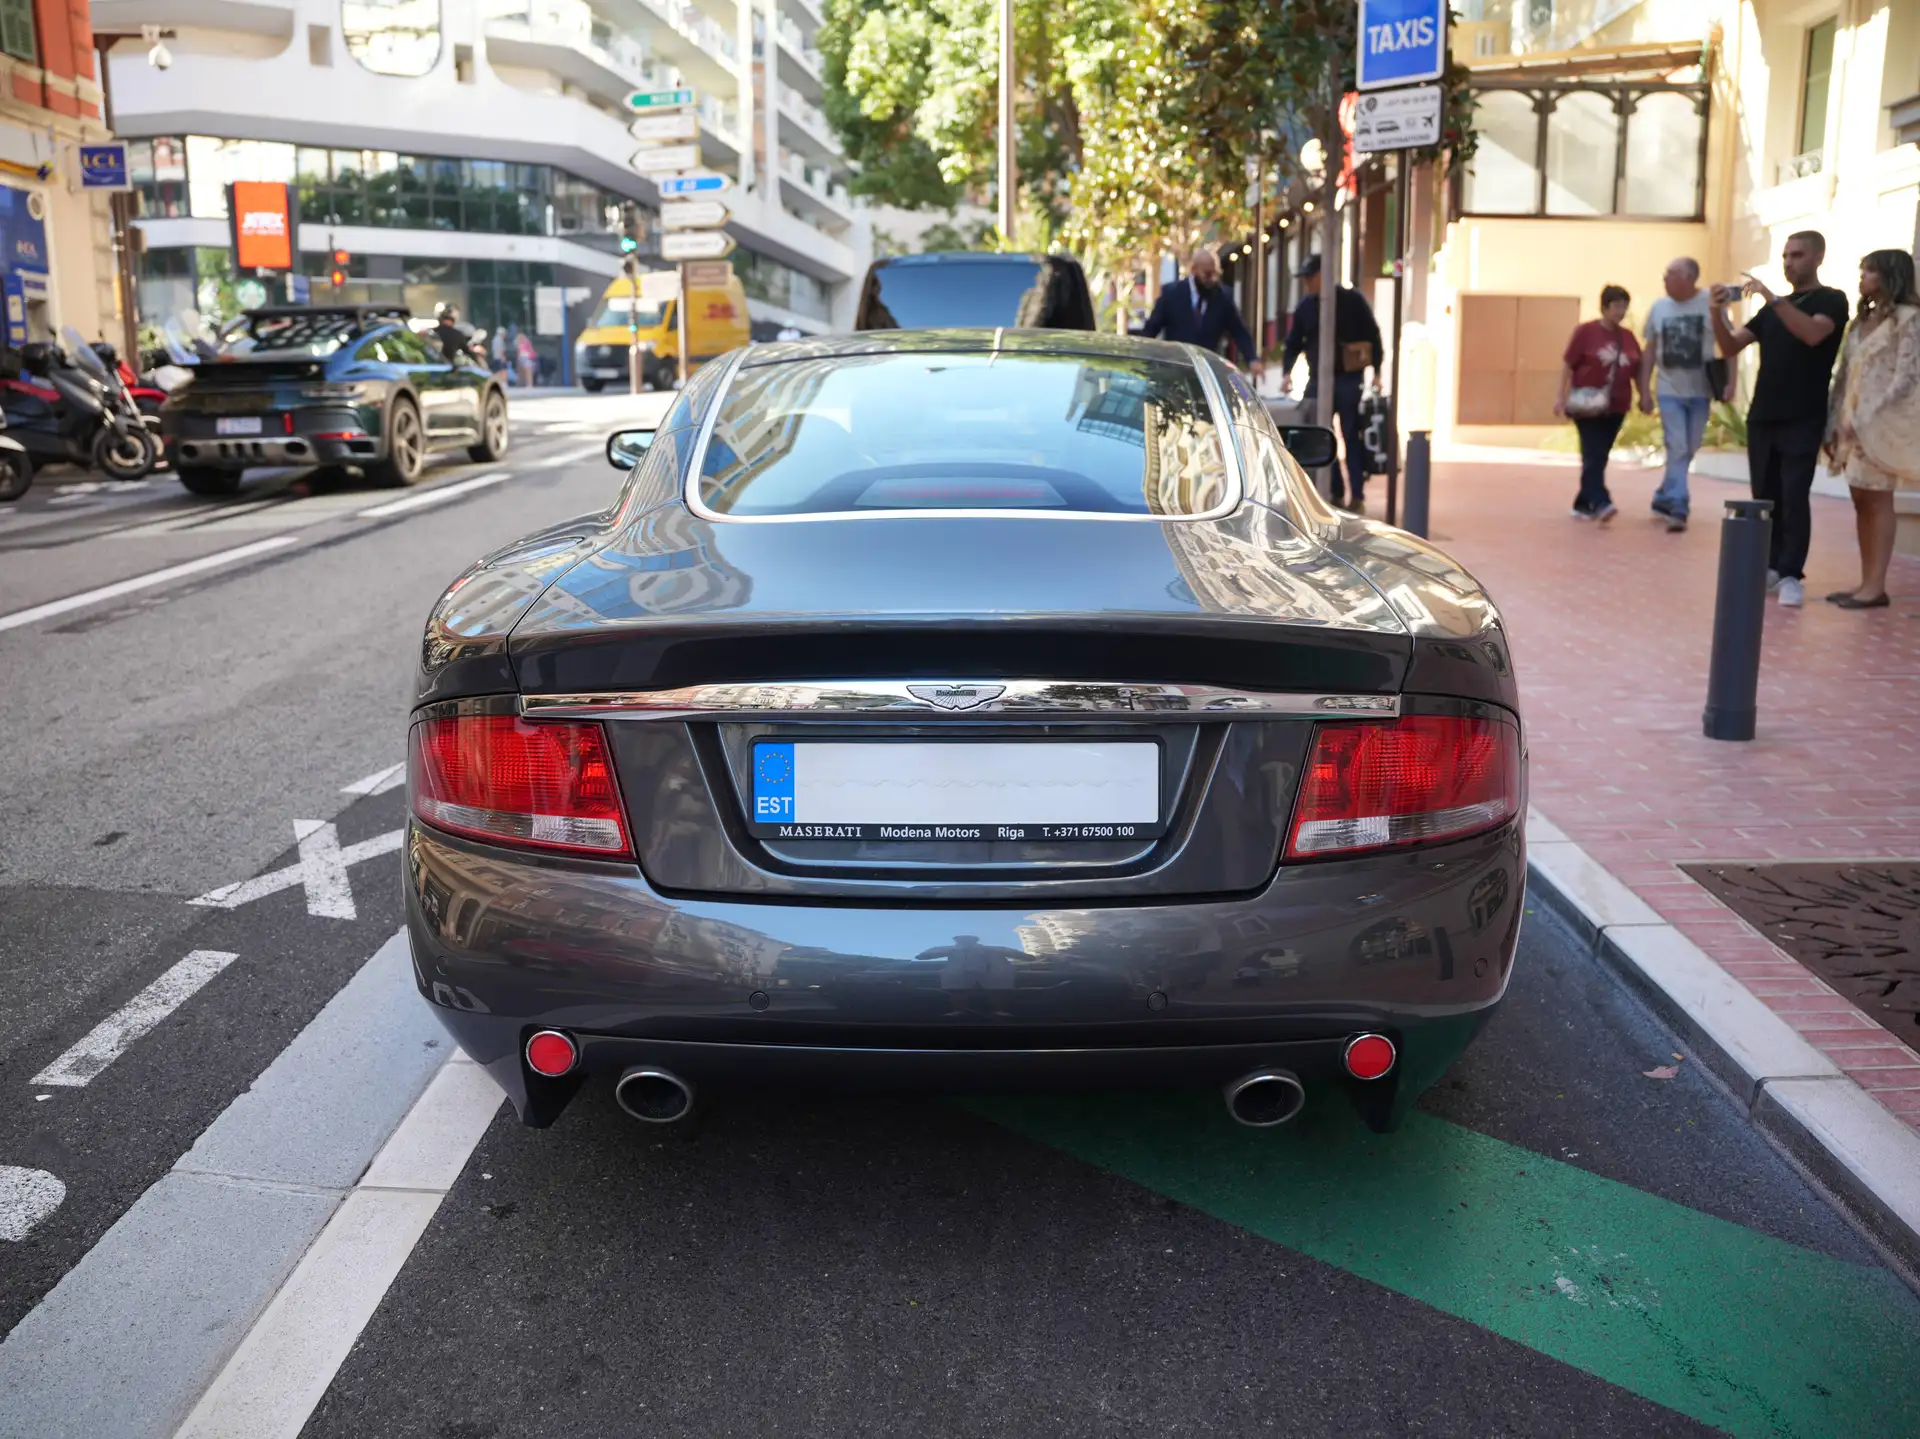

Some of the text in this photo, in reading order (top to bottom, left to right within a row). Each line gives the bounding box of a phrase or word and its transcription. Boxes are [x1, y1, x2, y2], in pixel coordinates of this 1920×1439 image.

[1367, 15, 1434, 55] TAXIS
[757, 797, 792, 814] EST
[779, 826, 862, 837] MASERATI
[880, 826, 931, 838] Modena
[935, 827, 980, 838] Motors
[998, 827, 1025, 840] Riga
[1054, 827, 1078, 837] +371
[1082, 827, 1113, 837] 67500
[1116, 826, 1135, 836] 100
